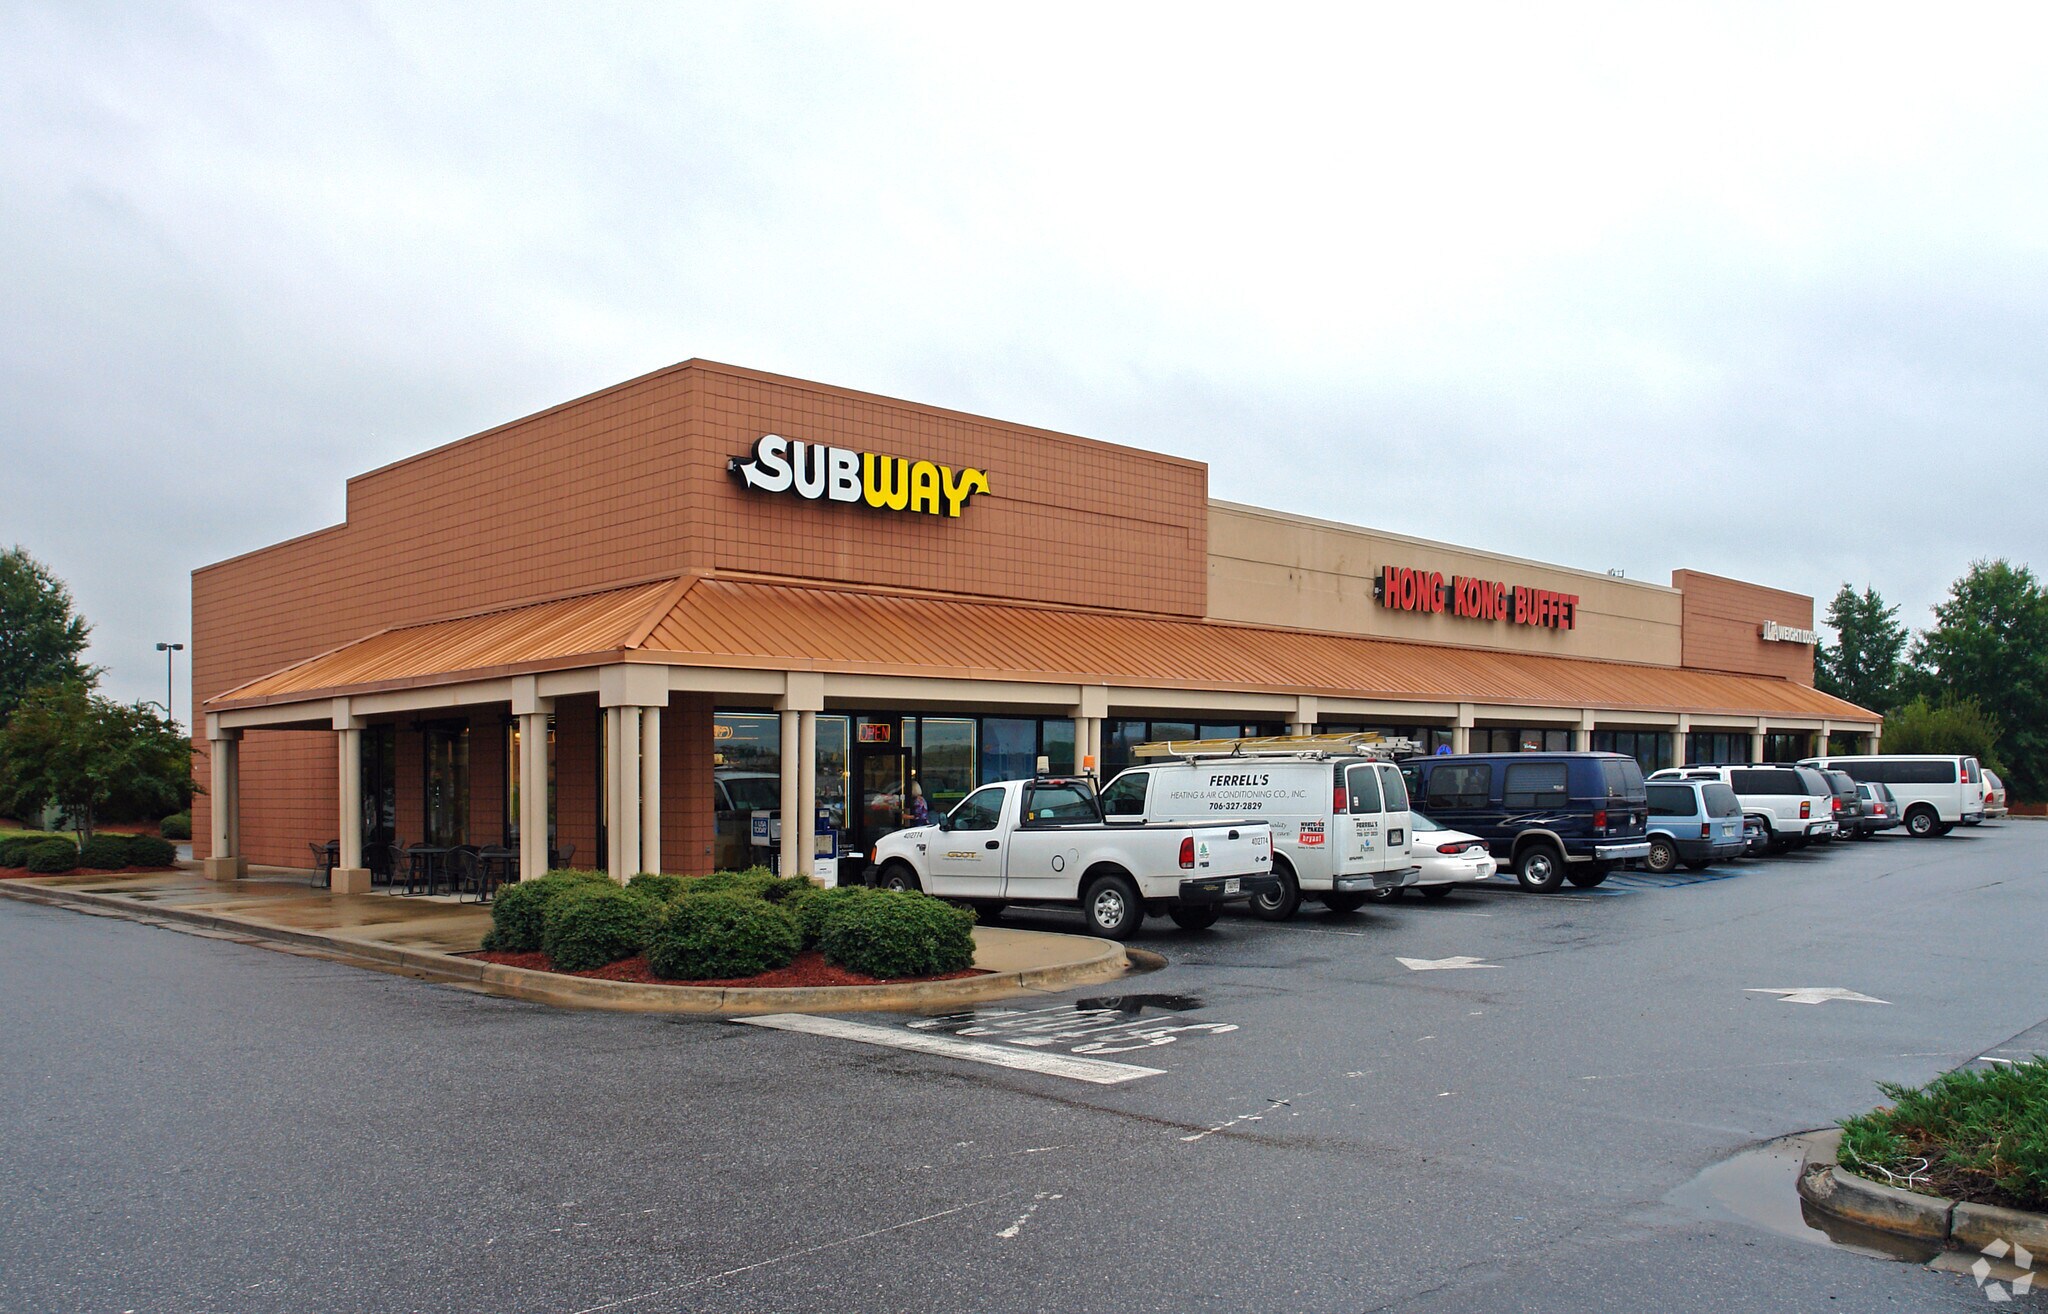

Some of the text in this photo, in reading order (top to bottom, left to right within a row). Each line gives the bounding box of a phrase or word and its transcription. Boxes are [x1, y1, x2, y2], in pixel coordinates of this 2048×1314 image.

[741, 433, 991, 518] SUBWAY
[1383, 565, 1579, 630] HONG KONG BUFFET
[860, 725, 889, 741] OPEN
[1209, 774, 1269, 786] FERRELL'S
[1170, 791, 1198, 800] HEATING
[1199, 791, 1205, 799] &
[1206, 791, 1217, 799] AIR
[1218, 790, 1272, 799] CONDITIONING
[1291, 789, 1307, 798] INC.
[1302, 834, 1322, 843] bryant
